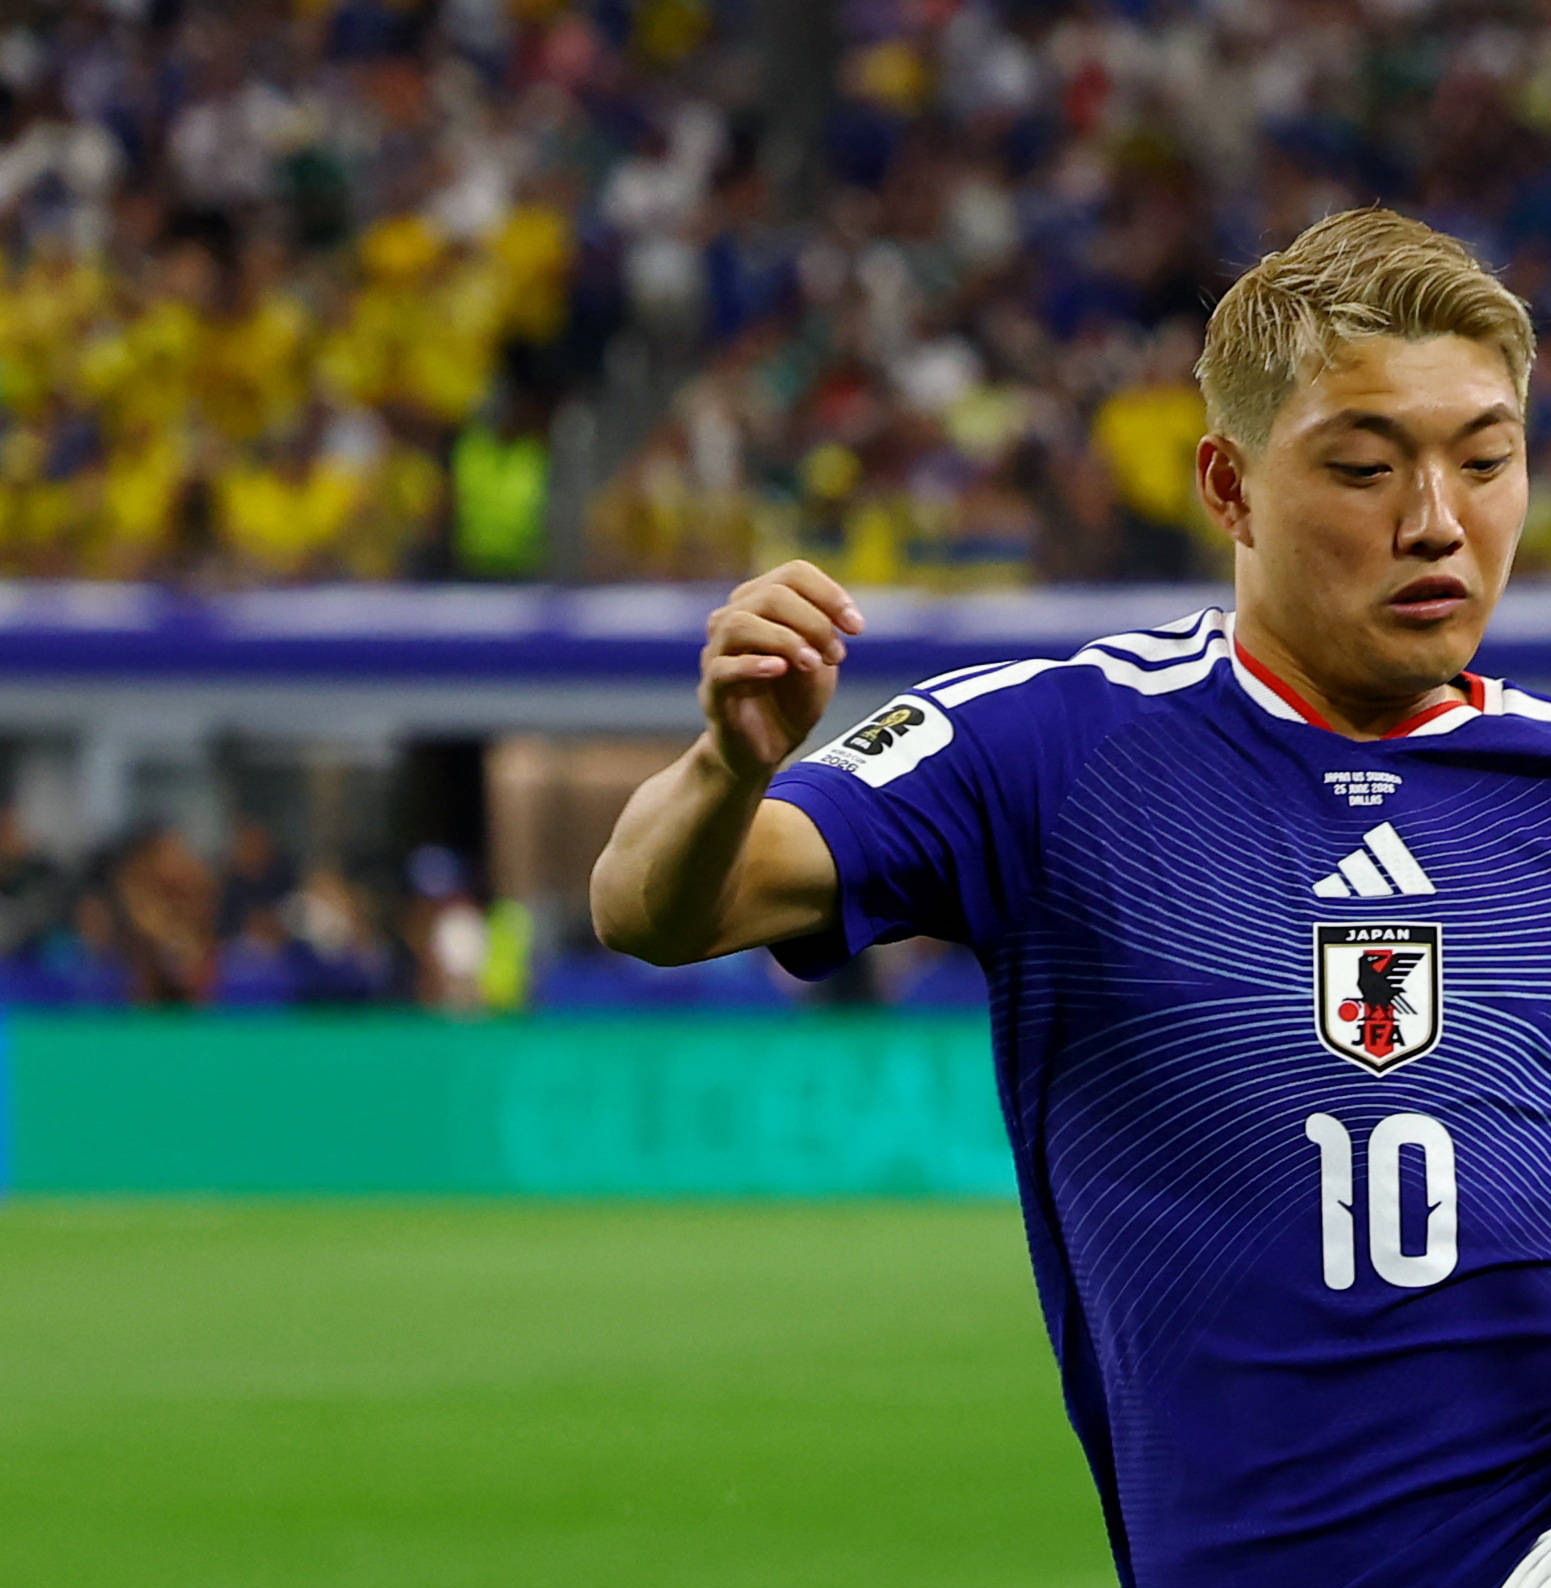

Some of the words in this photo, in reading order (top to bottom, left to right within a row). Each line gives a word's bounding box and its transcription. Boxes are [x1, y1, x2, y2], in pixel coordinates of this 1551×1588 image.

[1345, 928, 1410, 941] JAPAN
[1351, 1024, 1406, 1047] JFA
[1305, 1112, 1458, 1290] 10
